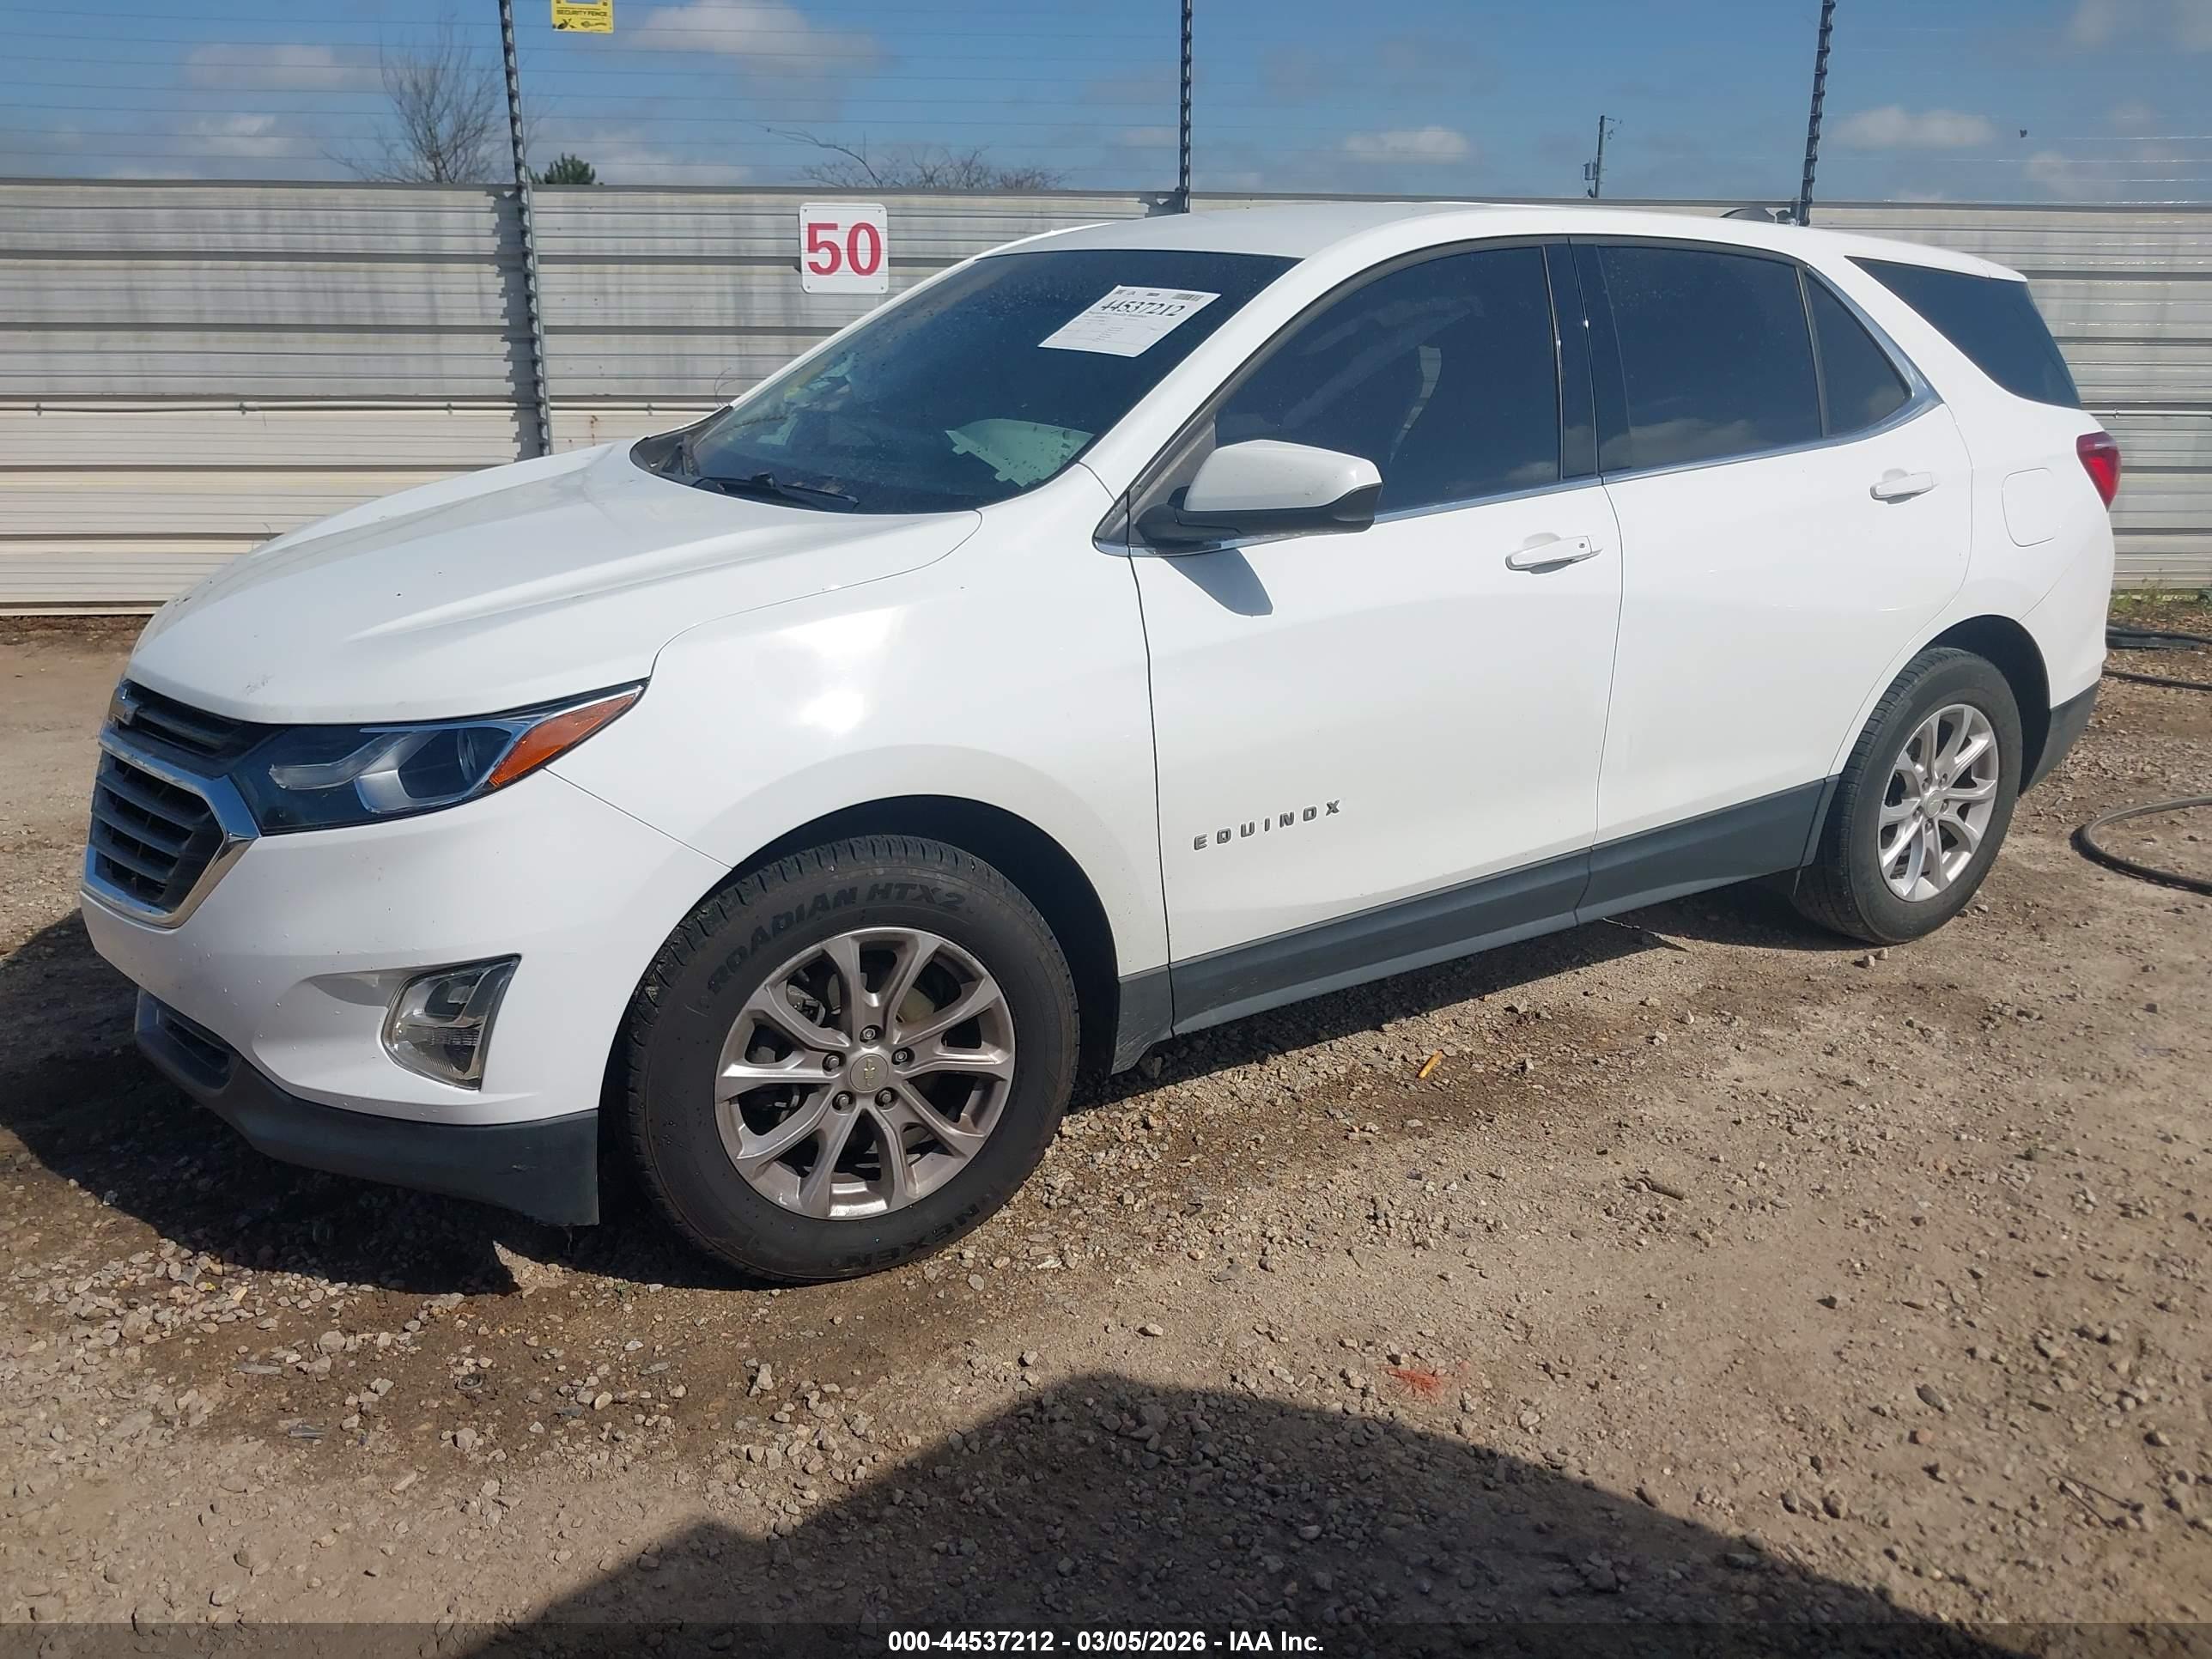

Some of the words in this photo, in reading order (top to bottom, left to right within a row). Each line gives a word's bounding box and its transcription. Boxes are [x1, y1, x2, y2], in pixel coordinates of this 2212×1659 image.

[807, 222, 882, 276] 50
[1100, 300, 1186, 317] 44537212
[1194, 799, 1340, 851] EQUINOX
[707, 886, 858, 993] ROADIAN
[866, 882, 967, 912] HTX2
[844, 1201, 981, 1269] NEXEN
